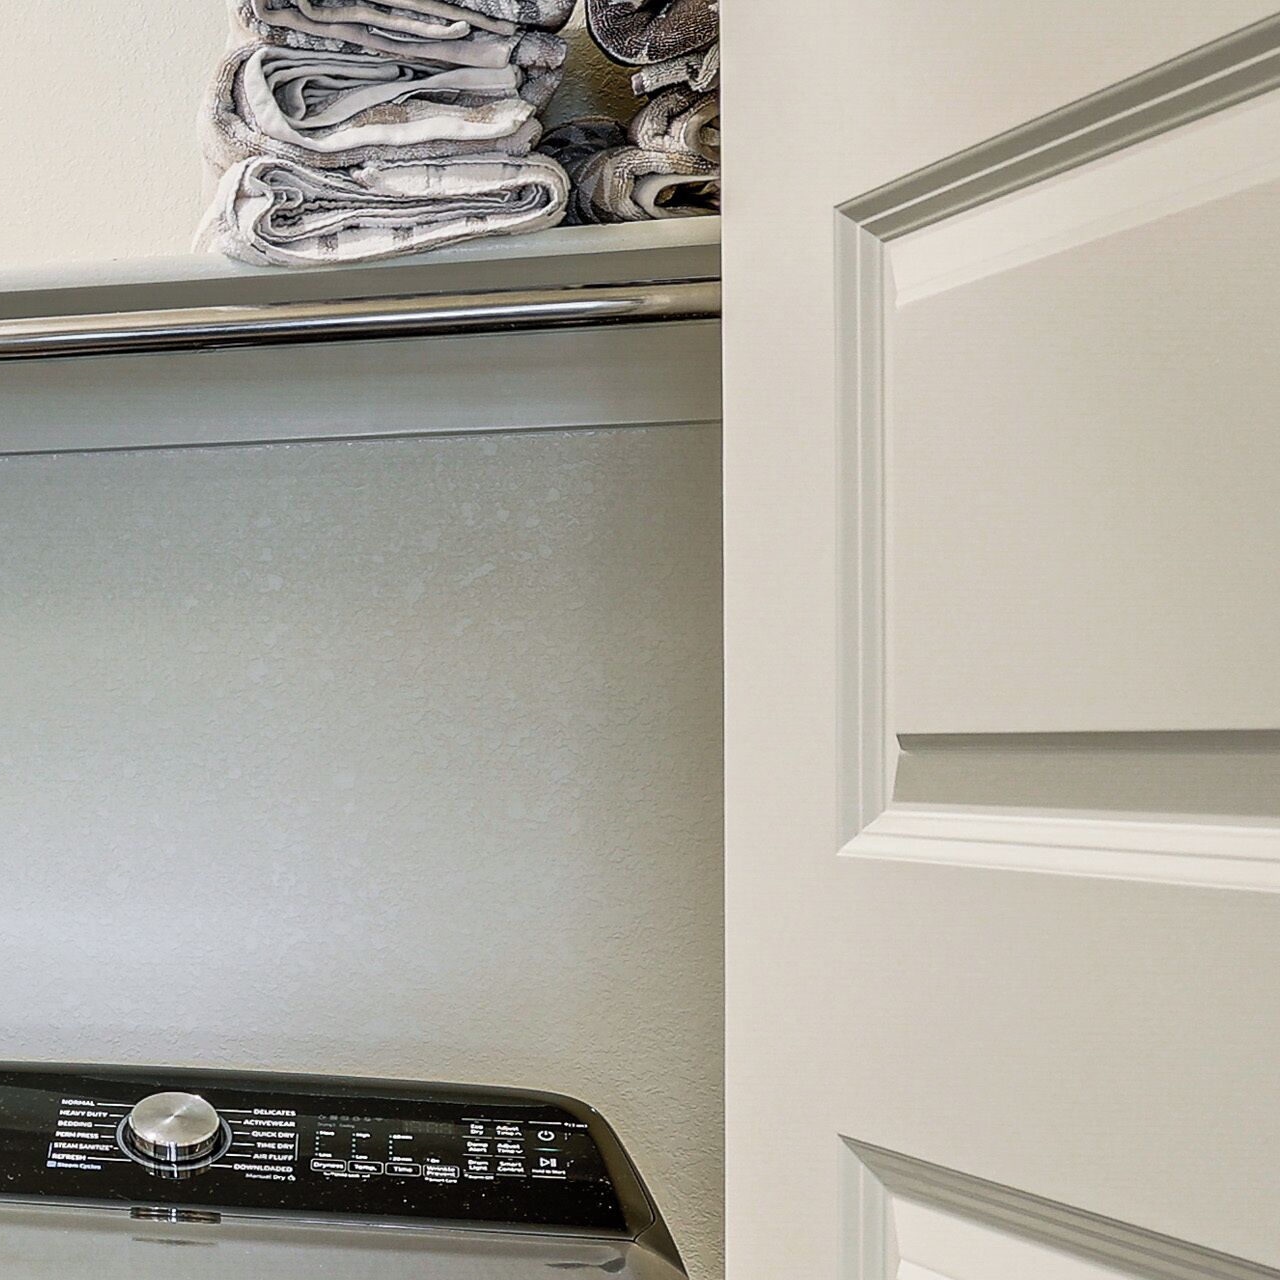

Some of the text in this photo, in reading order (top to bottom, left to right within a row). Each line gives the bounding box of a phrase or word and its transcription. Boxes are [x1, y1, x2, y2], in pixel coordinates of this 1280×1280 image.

[253, 1108, 296, 1116] DELICATES
[243, 1119, 295, 1127] ACTIVEWEAR
[233, 1163, 293, 1172] DOWNLOADED
